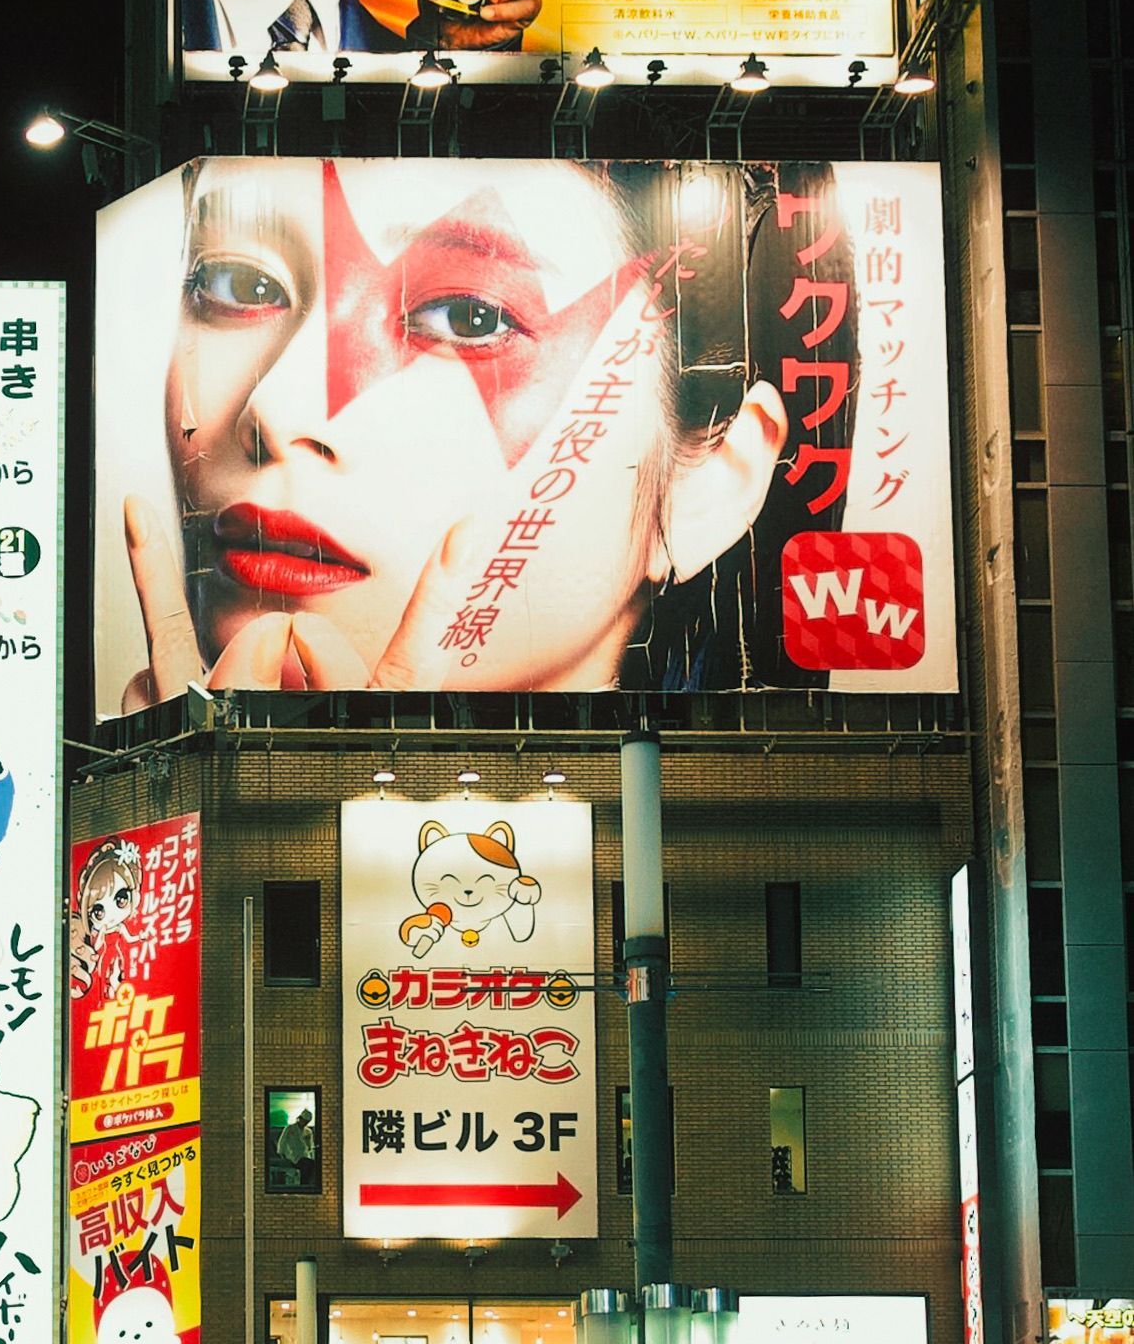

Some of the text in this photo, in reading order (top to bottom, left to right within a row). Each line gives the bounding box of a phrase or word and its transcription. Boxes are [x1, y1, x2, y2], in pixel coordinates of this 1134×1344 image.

[776, 192, 852, 517] ワクワク
[863, 195, 912, 512] 劇的マッチング
[139, 845, 163, 982] ガールズバー
[158, 834, 180, 946] コンカフェ
[175, 820, 199, 946] キャバクラ
[10, 922, 45, 1032] レモン
[389, 966, 551, 1011] カラオケ
[357, 1017, 581, 1089] まねきねこ
[90, 1133, 158, 1175] いちごなび
[110, 1145, 197, 1192] 今すぐ見つかる
[361, 1109, 579, 1155] 隣ビル 3F
[74, 1177, 186, 1257] 高収入
[92, 1223, 196, 1302] バイト
